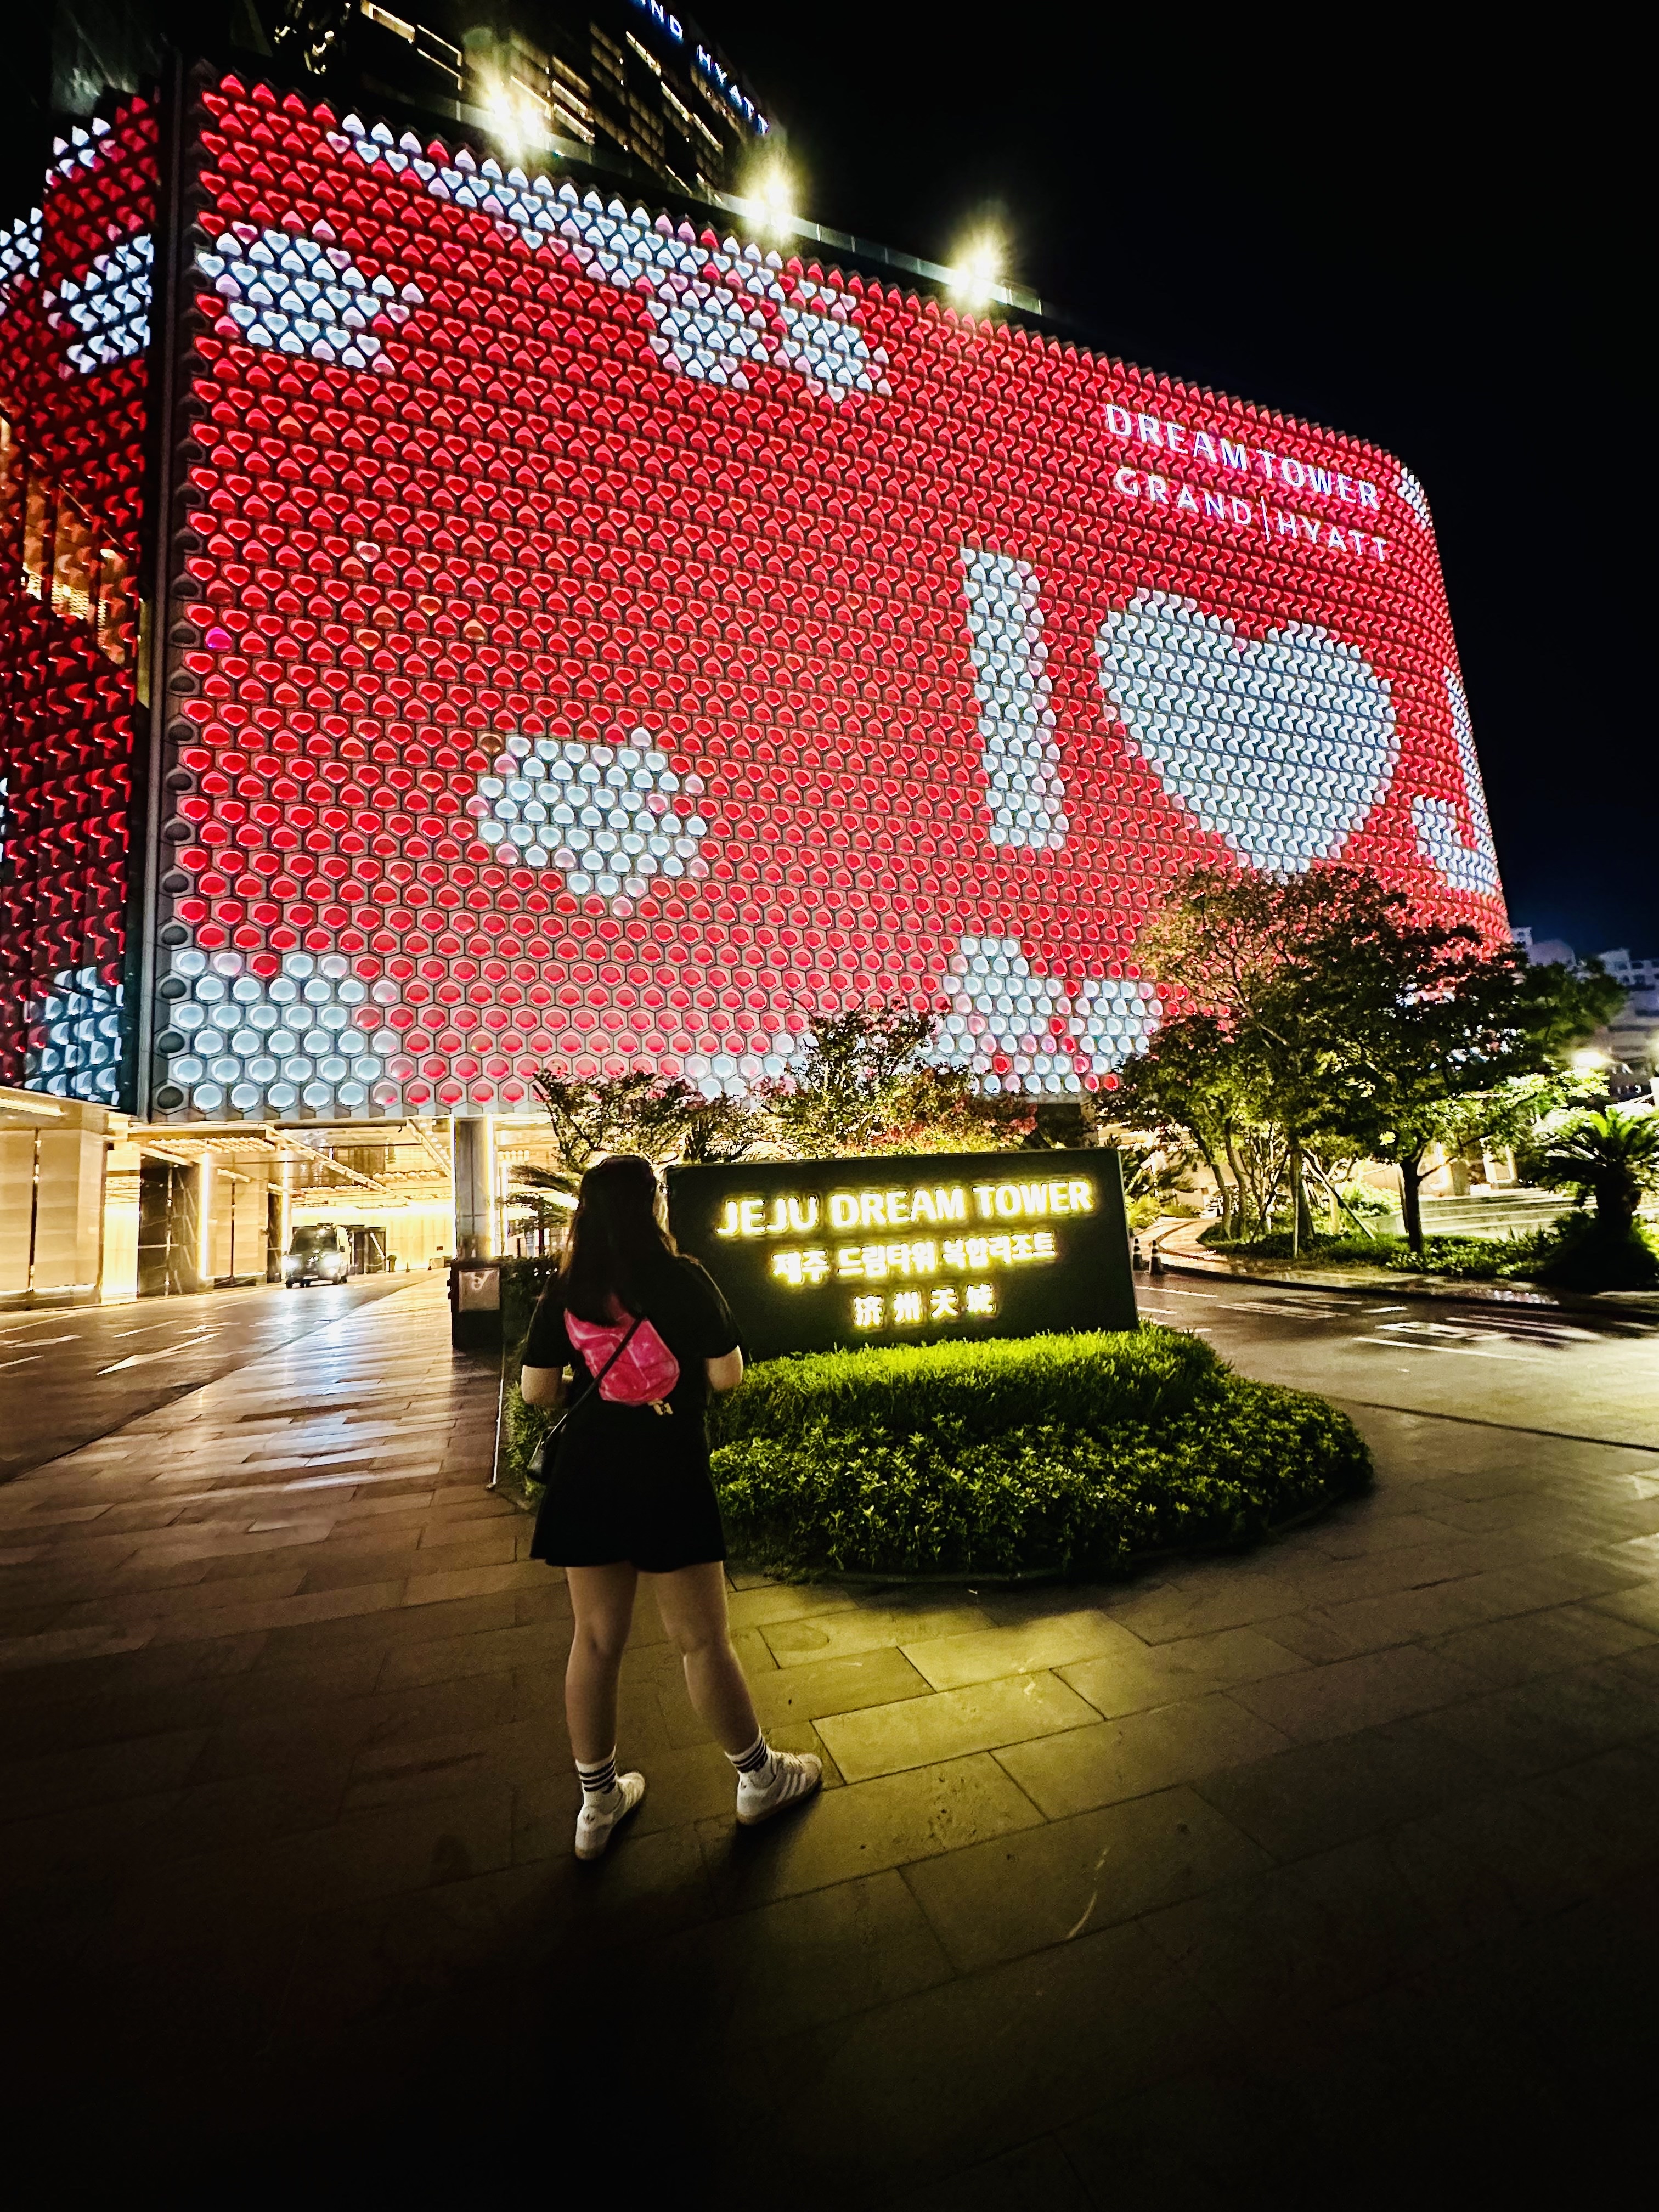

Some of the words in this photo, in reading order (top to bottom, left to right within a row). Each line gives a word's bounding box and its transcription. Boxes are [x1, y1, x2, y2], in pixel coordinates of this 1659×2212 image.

[697, 44, 769, 136] HYATT
[1106, 403, 1248, 472] DREAM
[1256, 448, 1381, 511] TOWER
[1115, 467, 1252, 526] GRAND
[1277, 510, 1387, 562] HYATT
[716, 1195, 819, 1237] JEJU
[830, 1187, 966, 1229] DREAM
[972, 1180, 1093, 1218] TOWER
[772, 1249, 830, 1284] 제주
[837, 1241, 936, 1279] 드림타워
[941, 1231, 1057, 1269] 복합리조트
